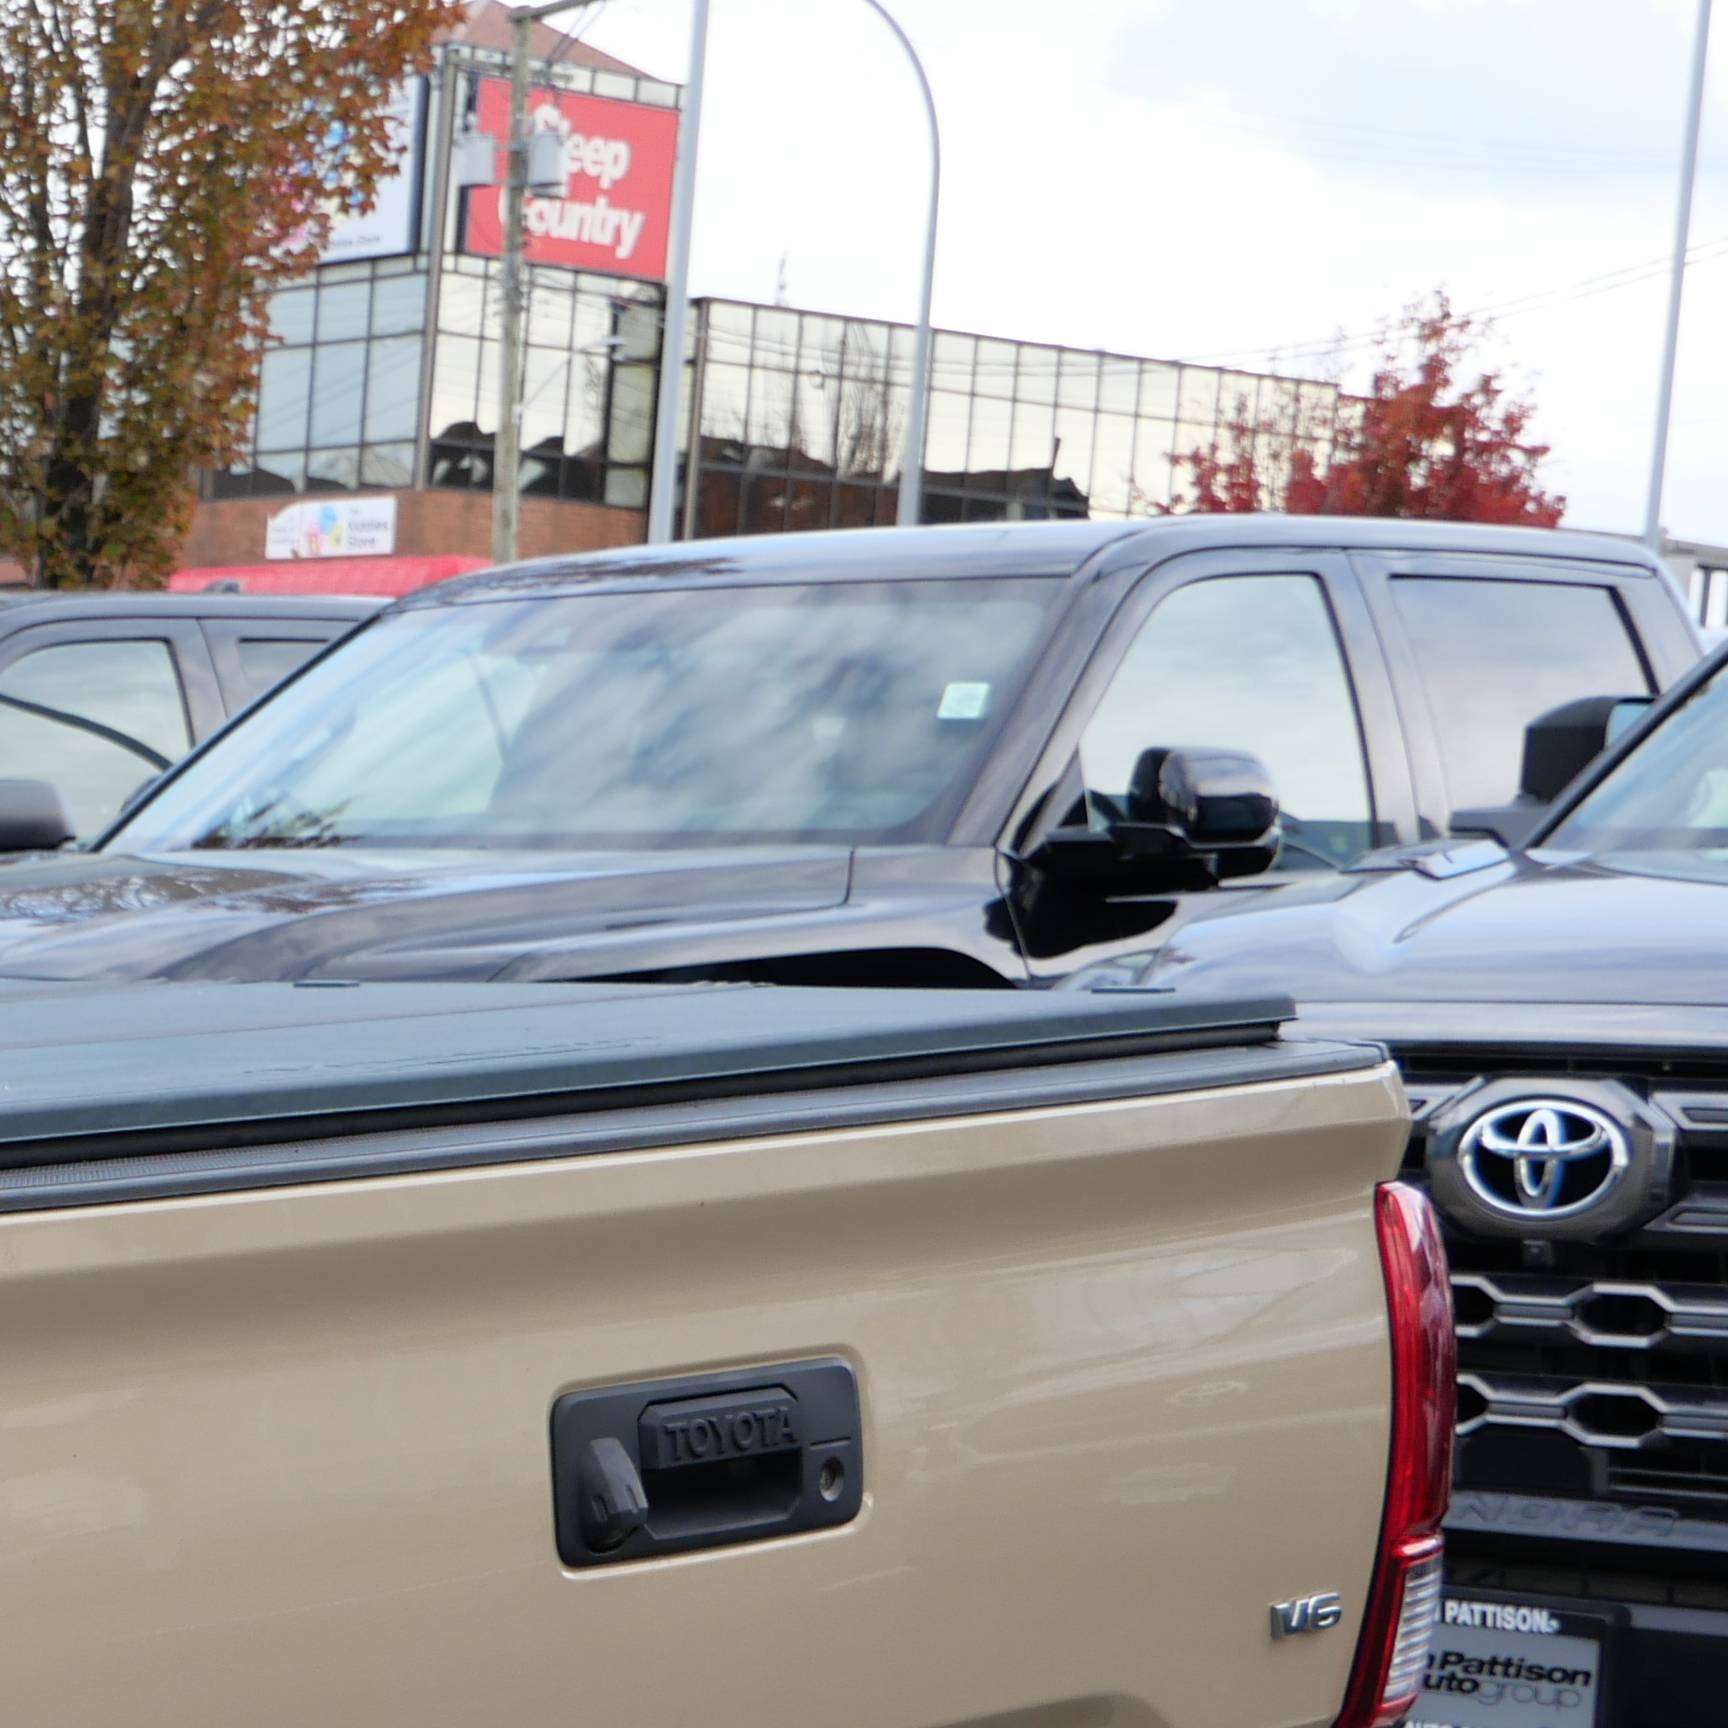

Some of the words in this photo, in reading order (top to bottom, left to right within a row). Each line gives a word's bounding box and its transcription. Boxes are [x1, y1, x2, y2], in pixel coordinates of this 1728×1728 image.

[662, 1406, 796, 1463] TOYOTA
[1270, 1592, 1342, 1640] V6
[1444, 1599, 1548, 1635] PATTISON
[1438, 1651, 1591, 1688] Pattison
